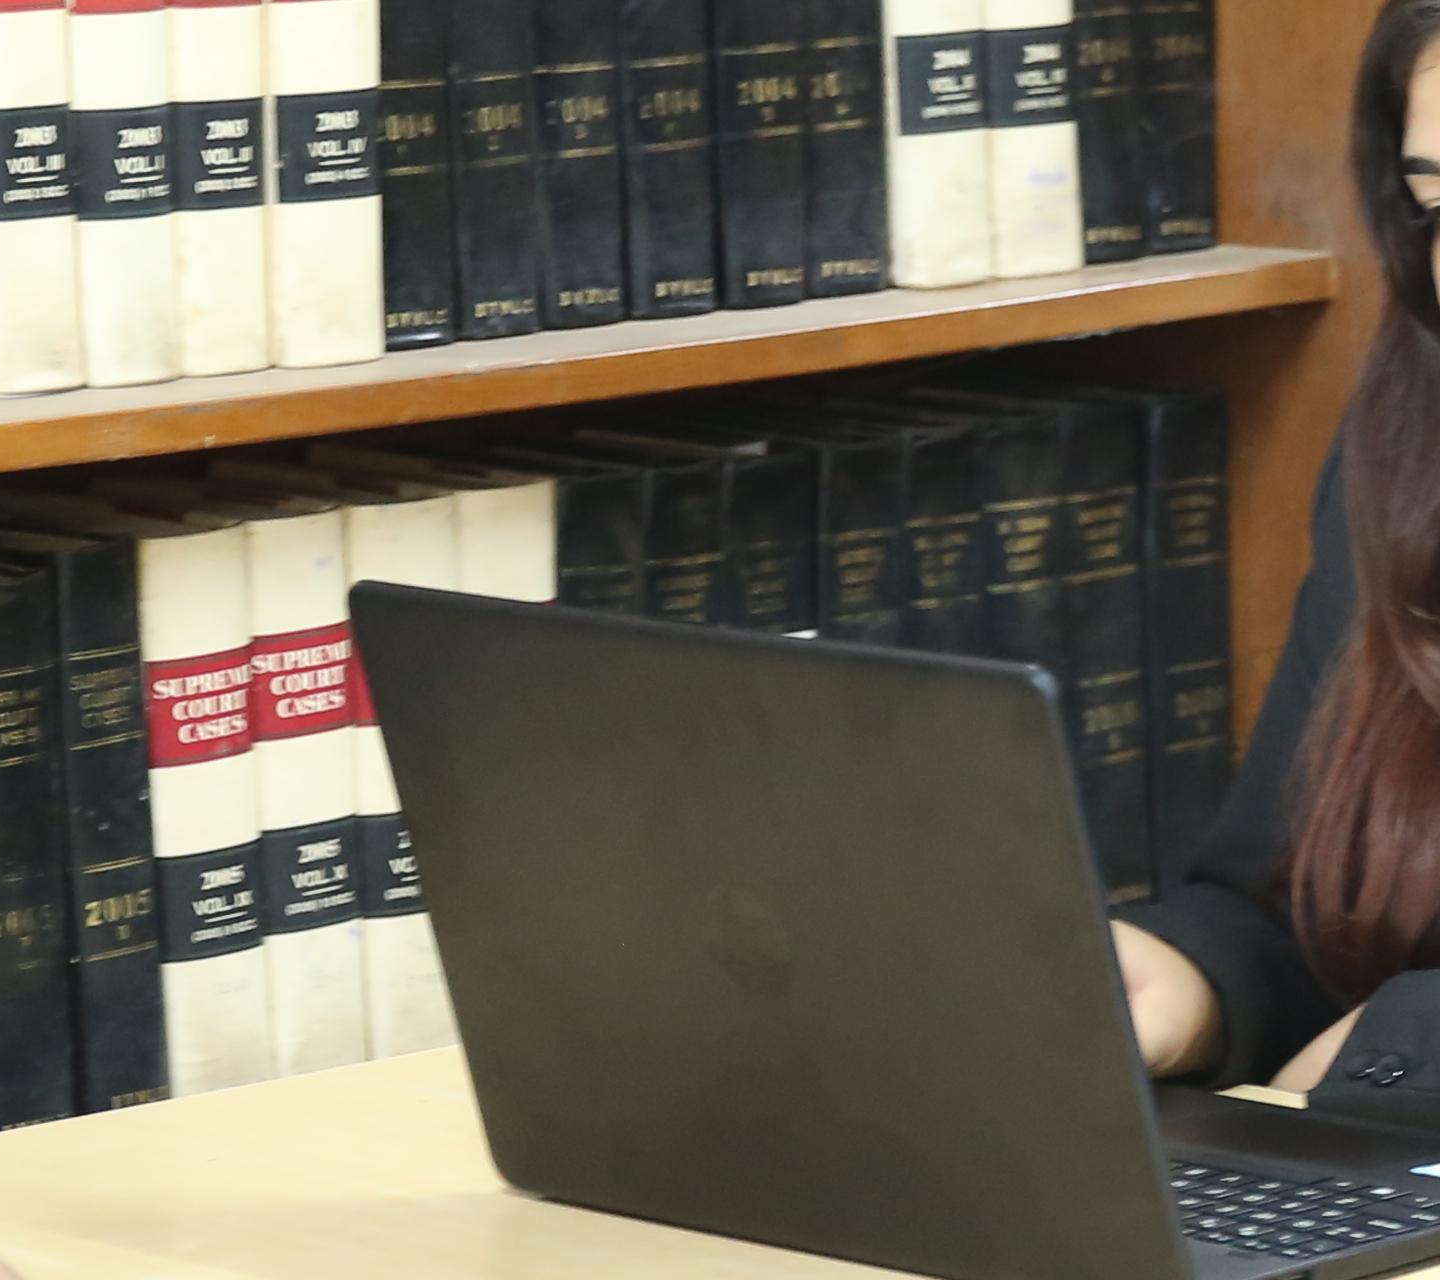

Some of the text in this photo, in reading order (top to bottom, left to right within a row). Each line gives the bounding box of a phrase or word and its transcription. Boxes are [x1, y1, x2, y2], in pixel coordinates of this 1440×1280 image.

[269, 665, 346, 695] COURT
[172, 689, 248, 721] COURT
[276, 690, 346, 719] CASES
[177, 714, 248, 744] CASES
